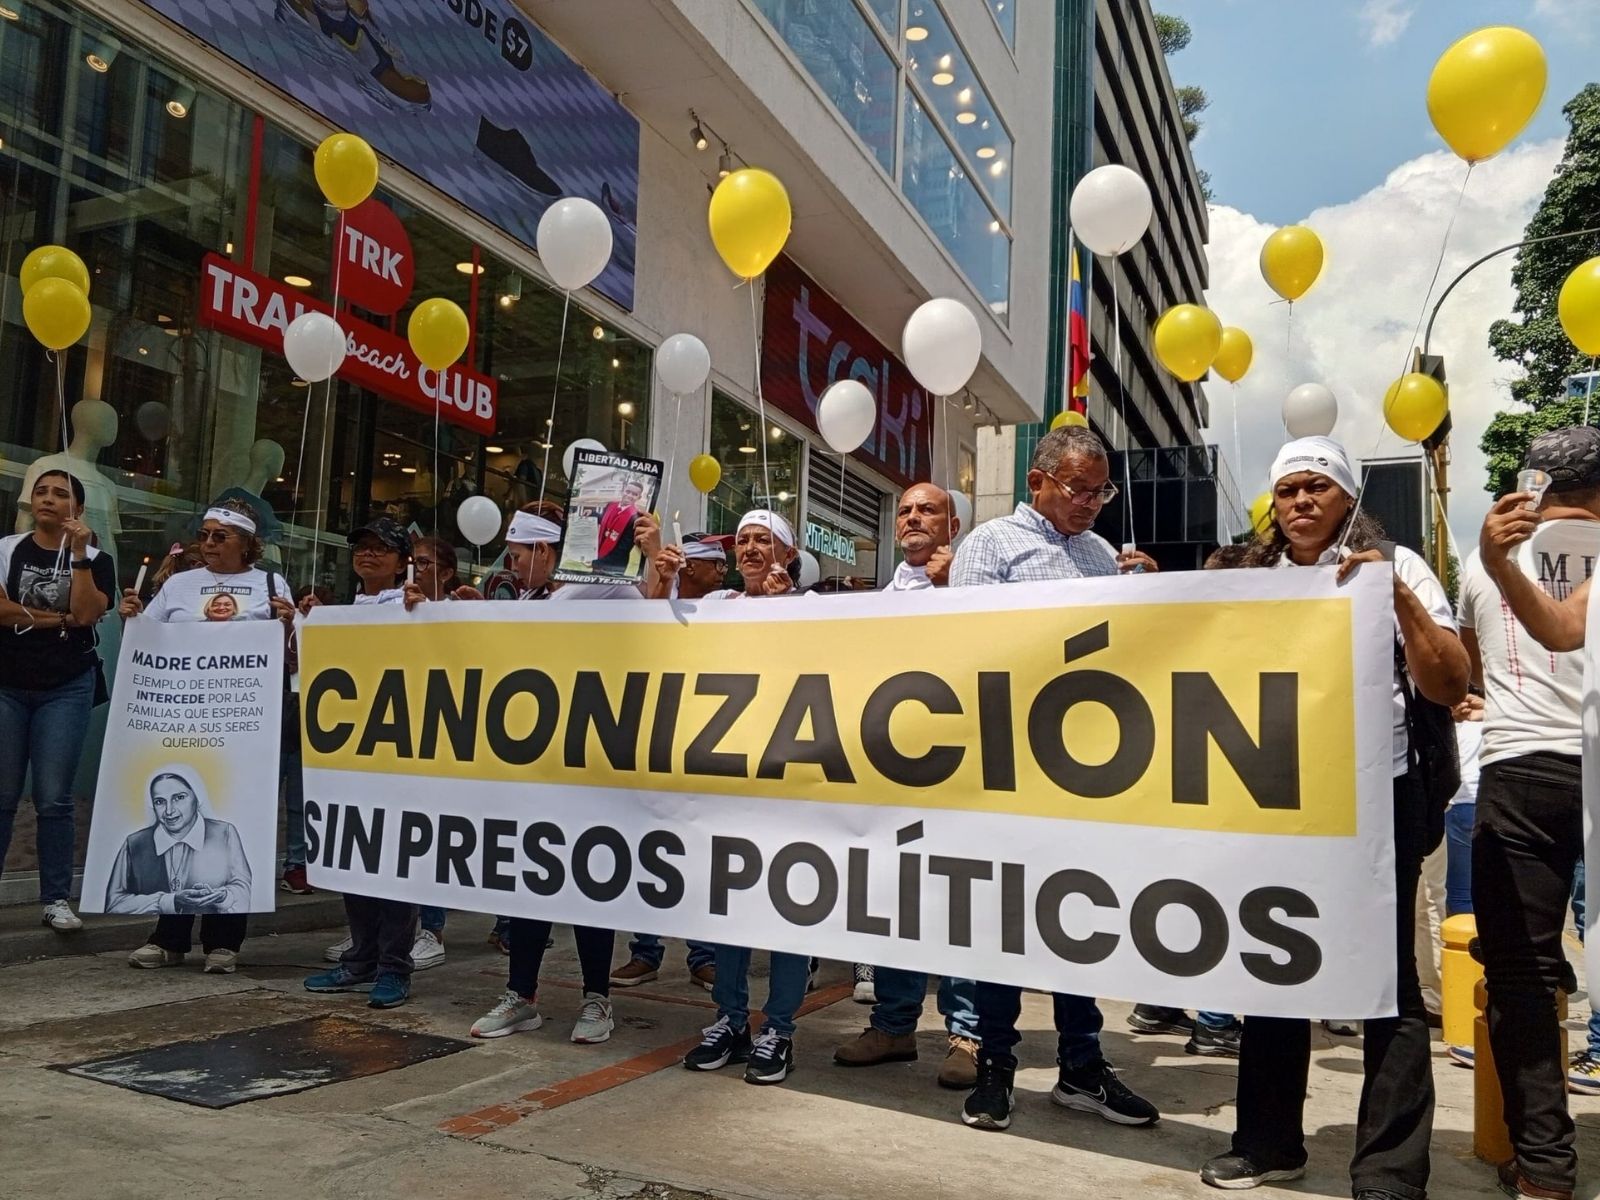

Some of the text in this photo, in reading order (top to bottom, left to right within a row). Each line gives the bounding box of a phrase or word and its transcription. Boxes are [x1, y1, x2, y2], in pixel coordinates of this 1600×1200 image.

[505, 26, 529, 58] $7
[345, 225, 404, 288] TRK
[208, 263, 494, 420] TRA beach CLUB
[578, 452, 659, 475] LIBERTAD PARA
[805, 521, 857, 566] NTRADA
[553, 572, 598, 585] KENNEDY
[132, 649, 269, 671] MADRE CARMEN
[132, 673, 187, 690] EJEMPLO
[189, 679, 205, 690] DE
[136, 689, 256, 704] INTERCEDE POR LAS
[126, 702, 264, 719] FAMILIAS QUE ESPERAN
[305, 620, 1301, 810] CANONIZACIÓN
[127, 718, 260, 733] ABRAZAR A SUS SERES
[162, 736, 225, 748] QUERIDOS
[304, 799, 1323, 986] SIN PRESOS POLÍTICOS
